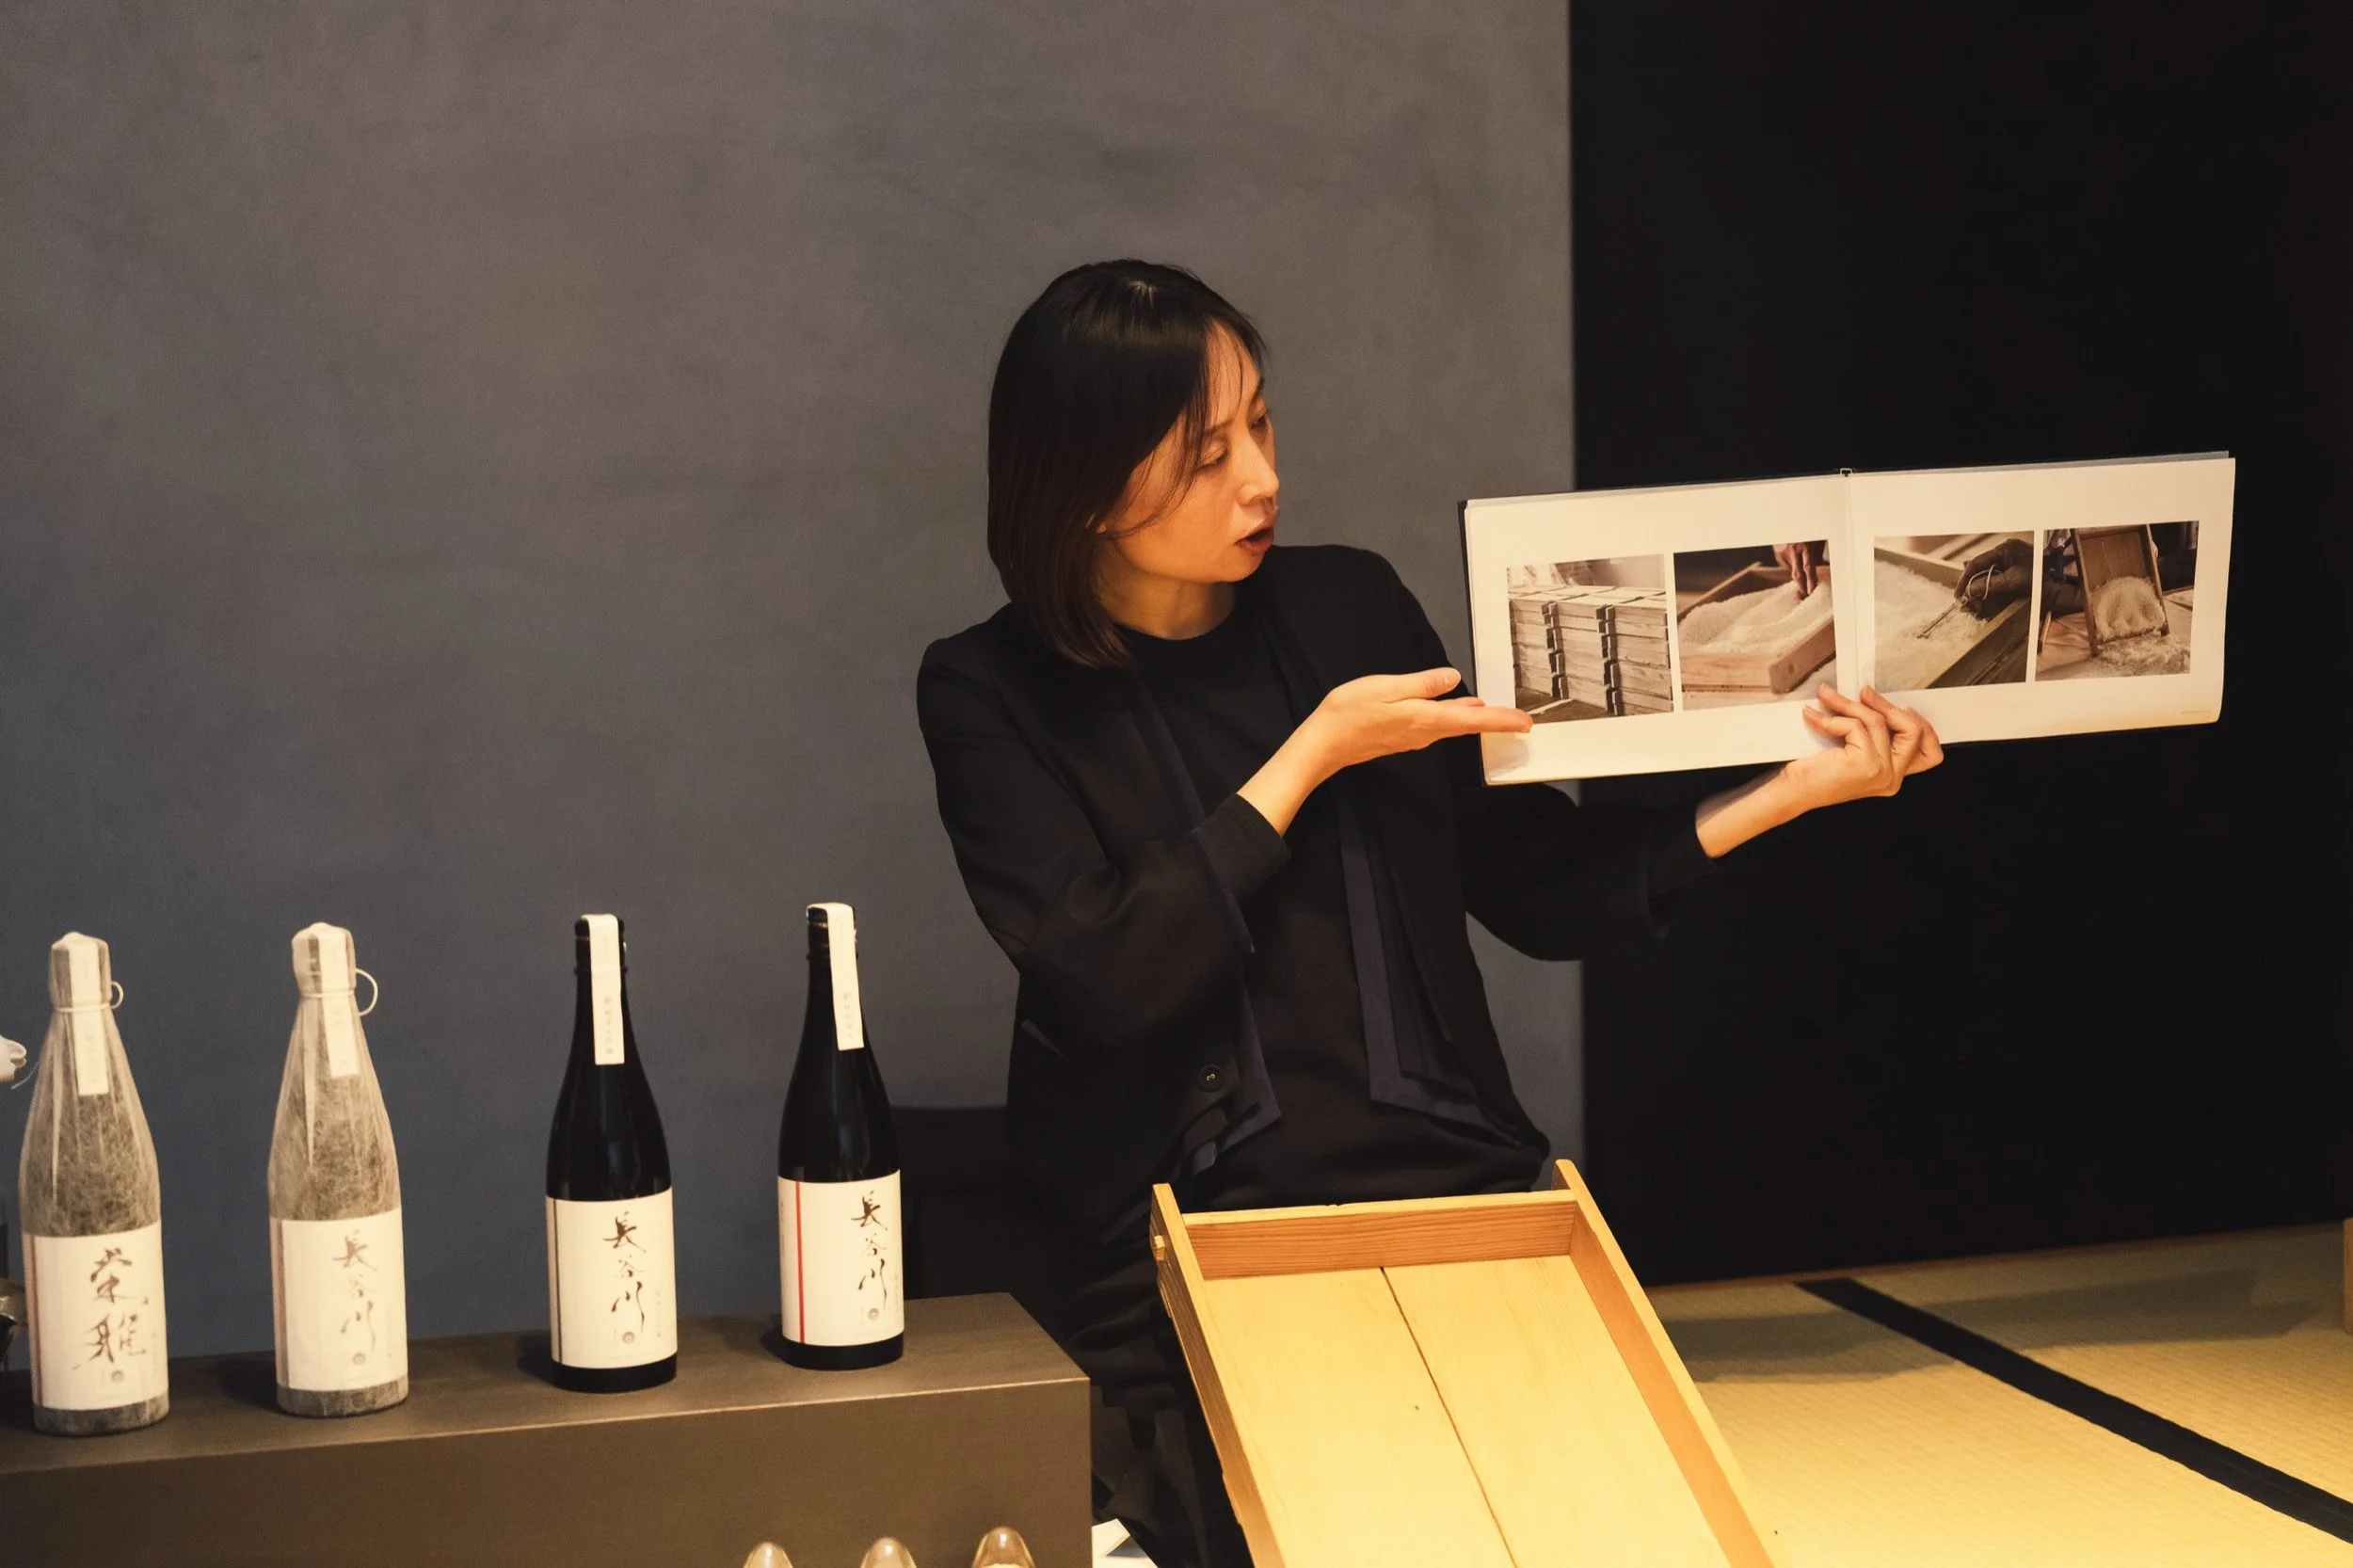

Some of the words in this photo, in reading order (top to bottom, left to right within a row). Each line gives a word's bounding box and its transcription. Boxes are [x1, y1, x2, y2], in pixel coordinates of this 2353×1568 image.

[332, 1228, 377, 1355] 長谷川
[602, 1210, 648, 1334] 長谷川
[851, 1190, 888, 1311] 長谷川
